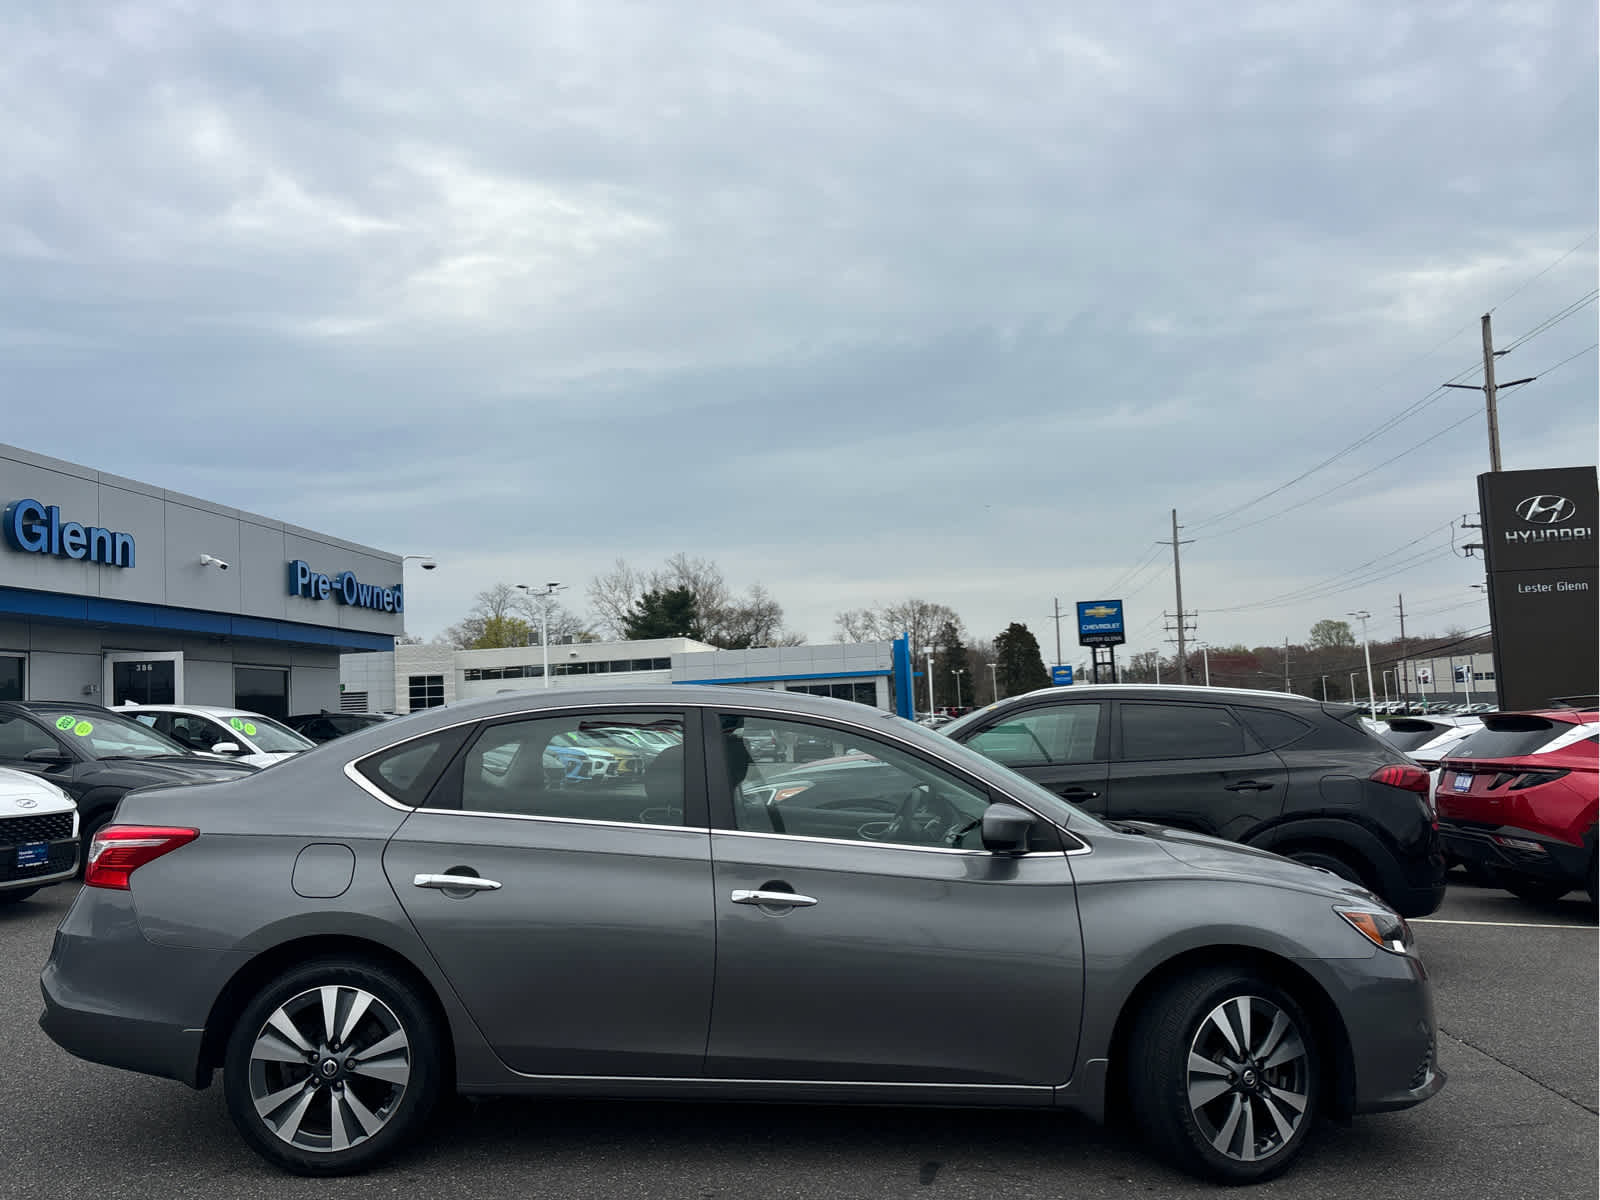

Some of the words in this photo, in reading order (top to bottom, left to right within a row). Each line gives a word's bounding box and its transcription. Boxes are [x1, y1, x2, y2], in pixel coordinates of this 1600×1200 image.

[1505, 528, 1591, 543] HYUNDAI
[4, 498, 136, 568] Glenn
[289, 560, 404, 613] Pre-Owned
[1518, 583, 1553, 593] Lester
[1556, 581, 1589, 592] Glenn
